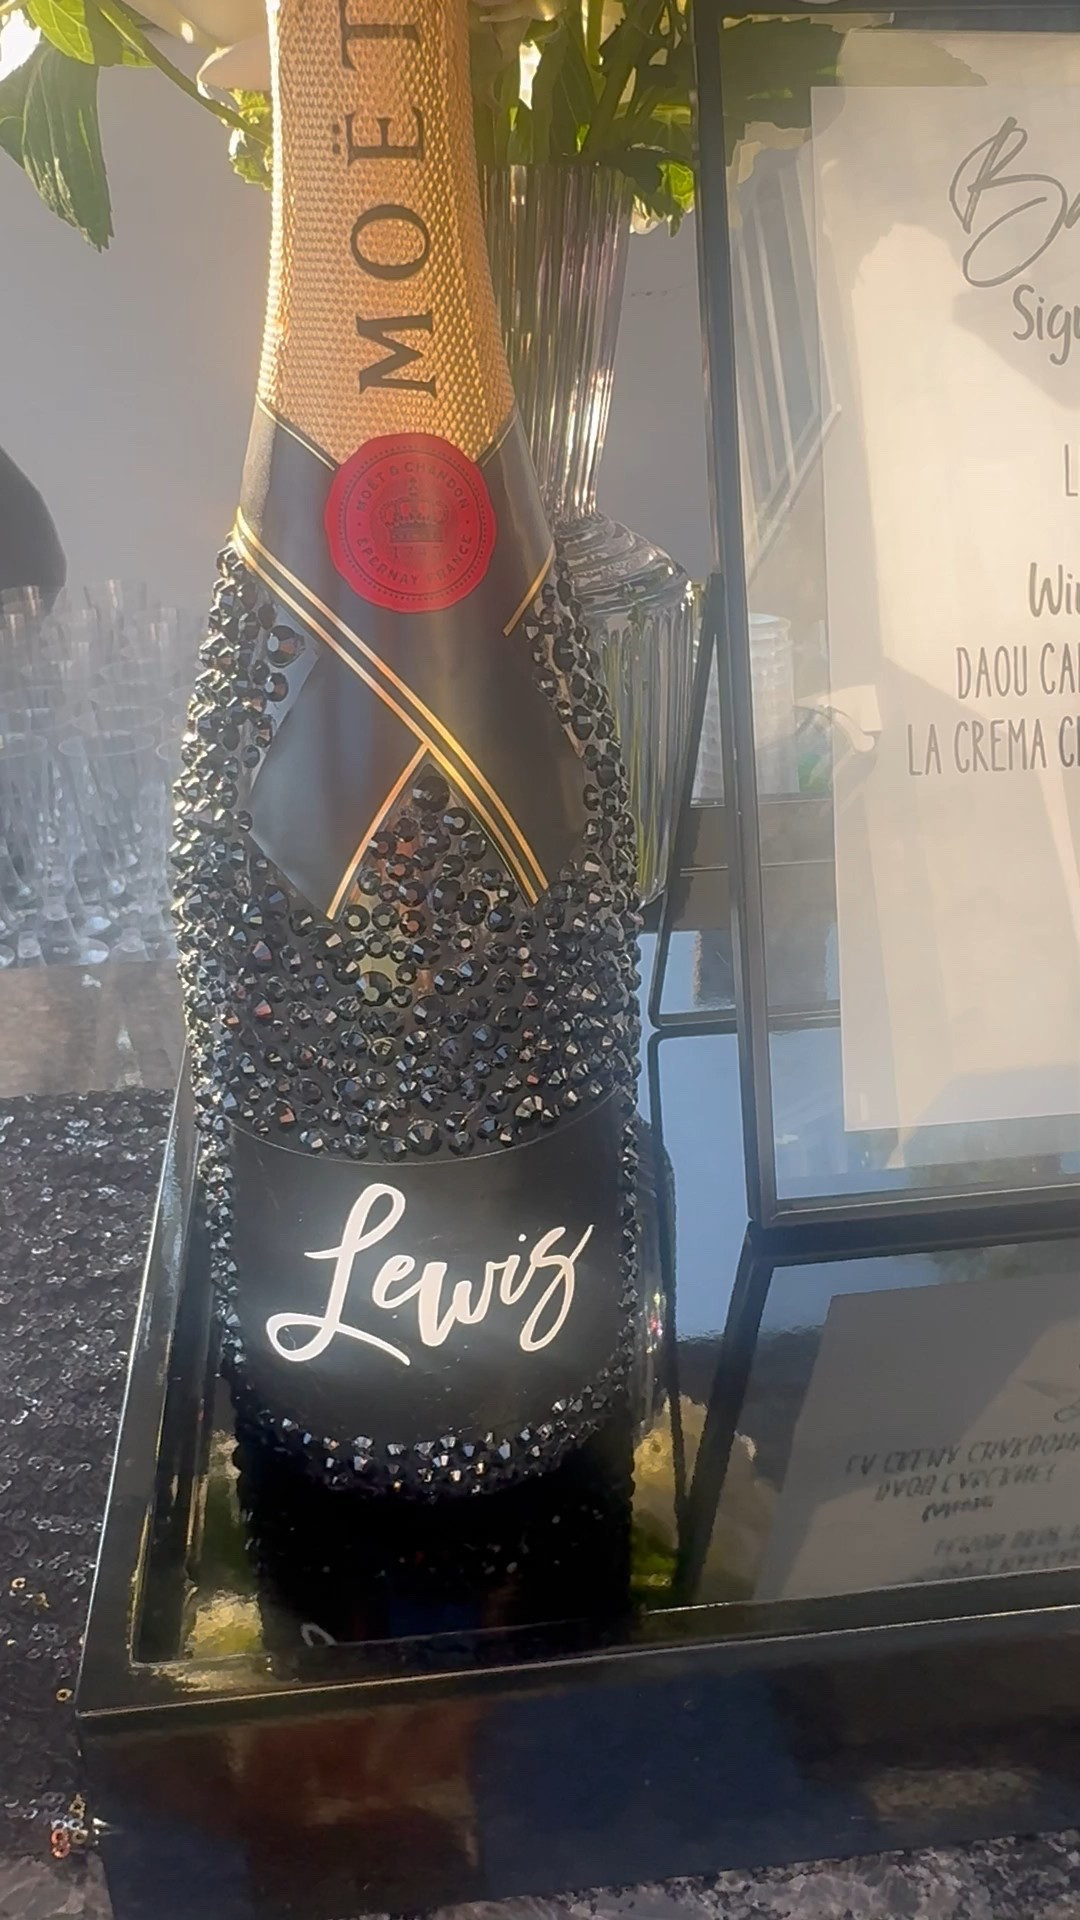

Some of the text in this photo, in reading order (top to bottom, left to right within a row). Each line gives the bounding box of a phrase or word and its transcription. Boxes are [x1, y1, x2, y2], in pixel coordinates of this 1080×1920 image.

[332, 0, 437, 398] MOËT
[949, 116, 1080, 288] B
[404, 462, 470, 509] CHANDON
[357, 534, 473, 585] EPERNAY FRANCE
[956, 642, 1080, 700] DAOU CA
[907, 715, 1080, 777] LA CREMA C
[266, 1182, 595, 1367] Lewis
